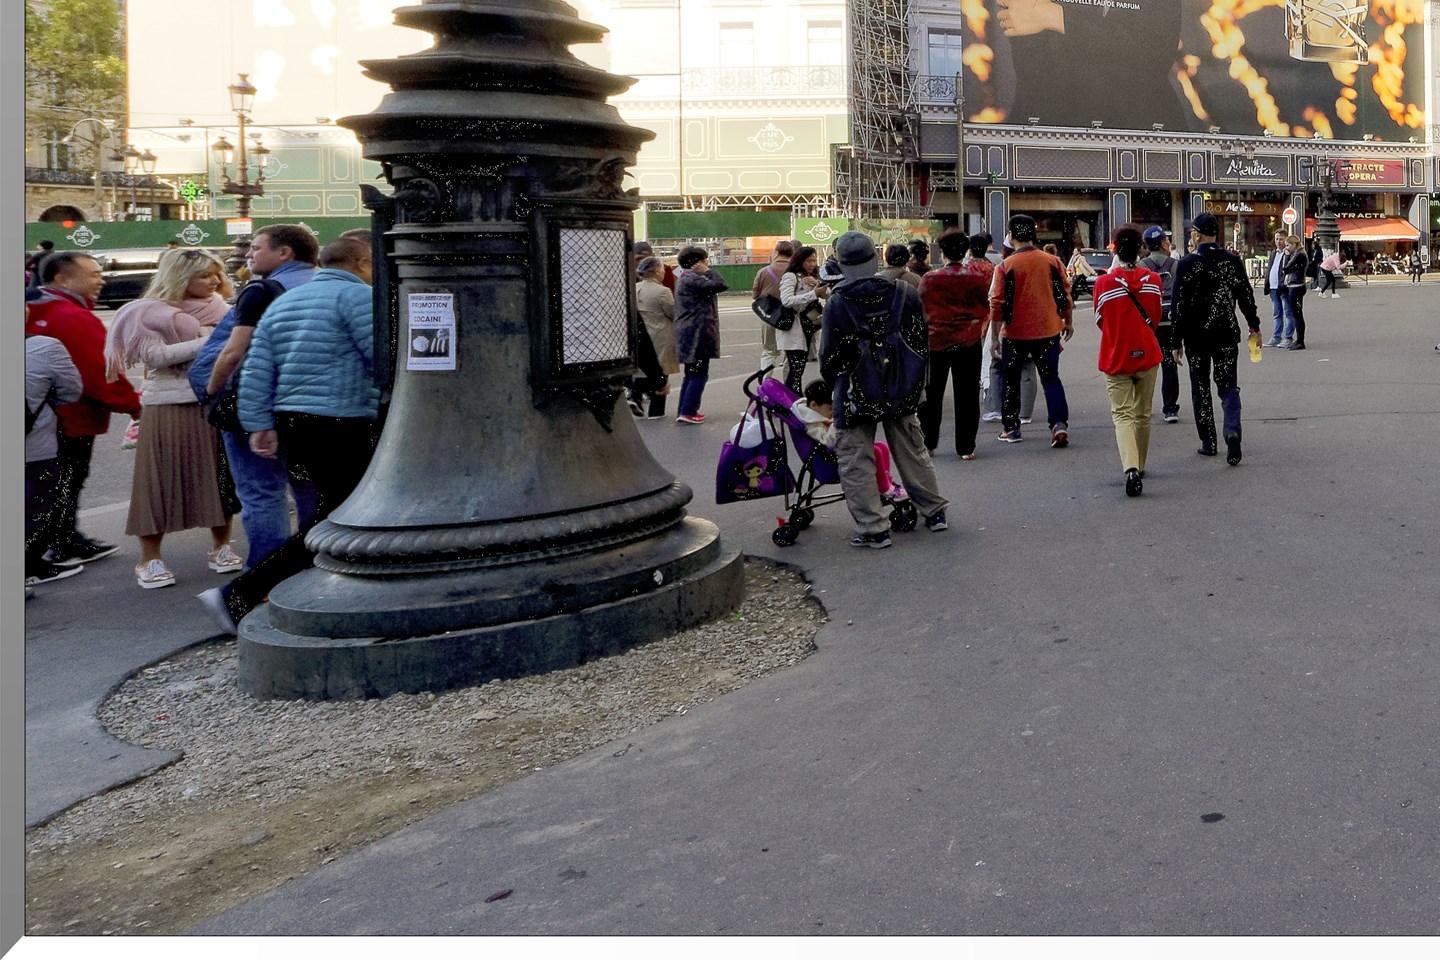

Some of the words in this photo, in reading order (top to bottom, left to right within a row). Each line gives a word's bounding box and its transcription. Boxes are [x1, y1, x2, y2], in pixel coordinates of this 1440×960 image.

[1116, 2, 1140, 10] PARFUM
[1226, 159, 1276, 176] Melvita
[1225, 202, 1254, 212] Mevita
